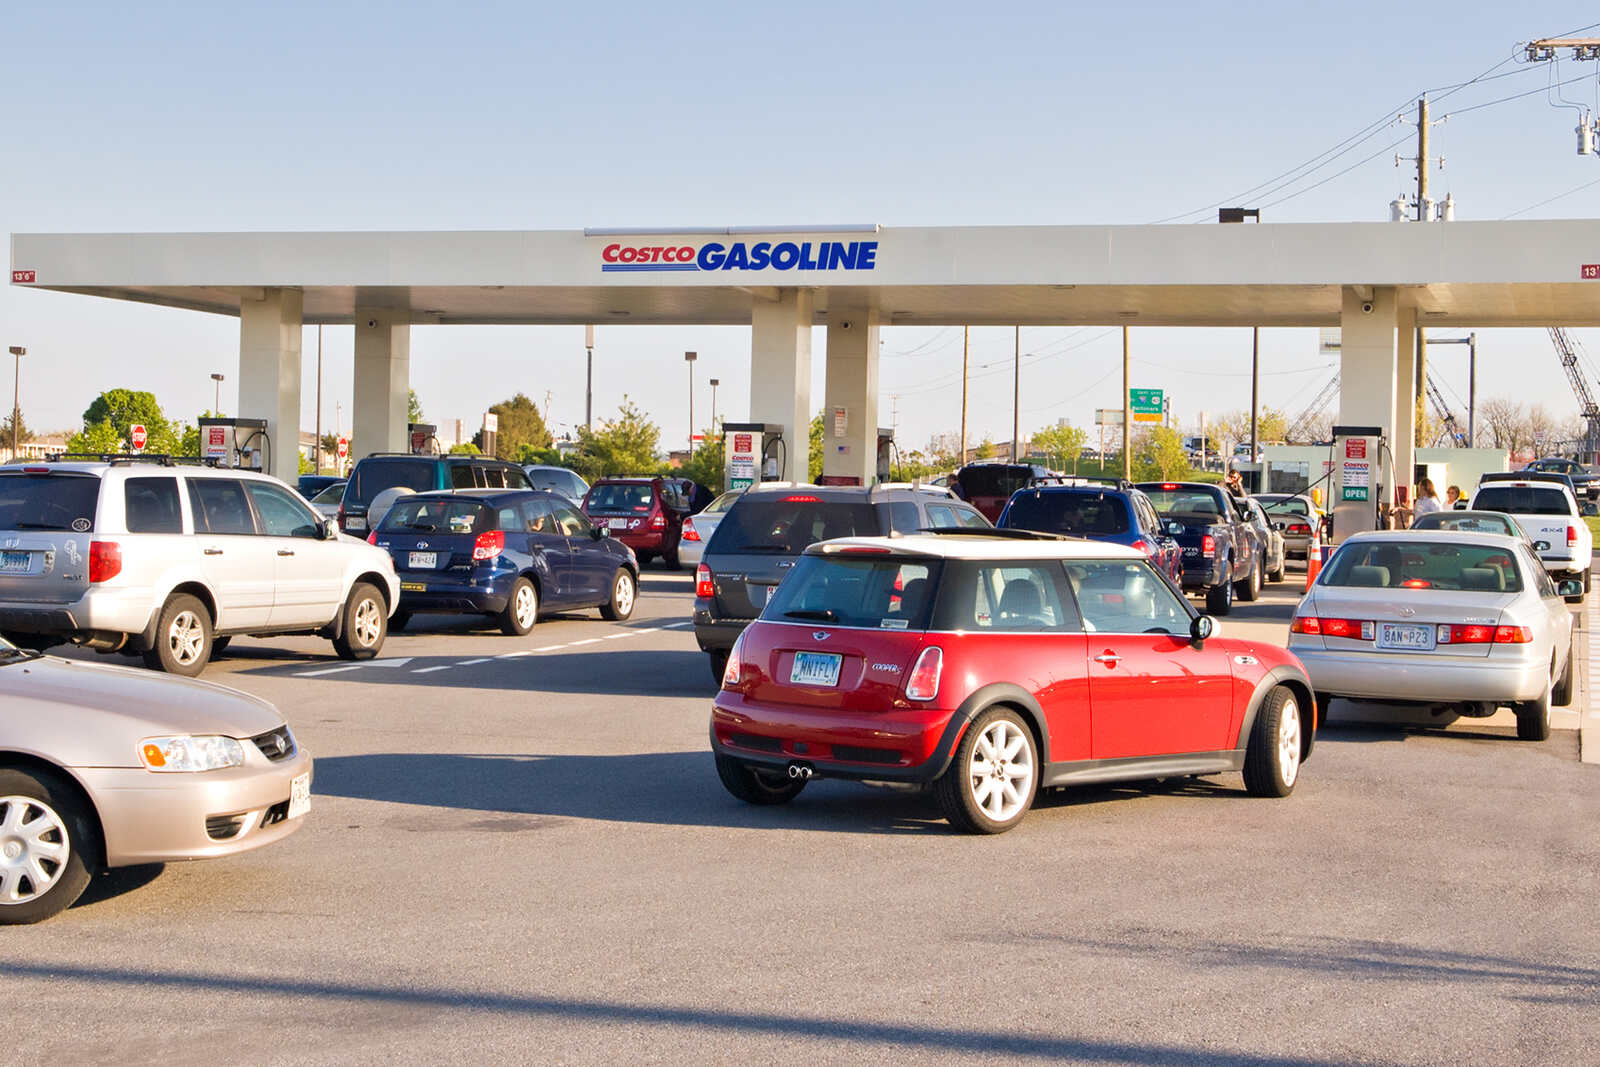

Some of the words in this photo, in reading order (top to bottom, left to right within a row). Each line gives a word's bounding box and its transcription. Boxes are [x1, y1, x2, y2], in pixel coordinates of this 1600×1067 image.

[602, 243, 695, 263] COSTCO
[697, 241, 878, 271] GASOLINE
[1345, 489, 1367, 498] OPEN
